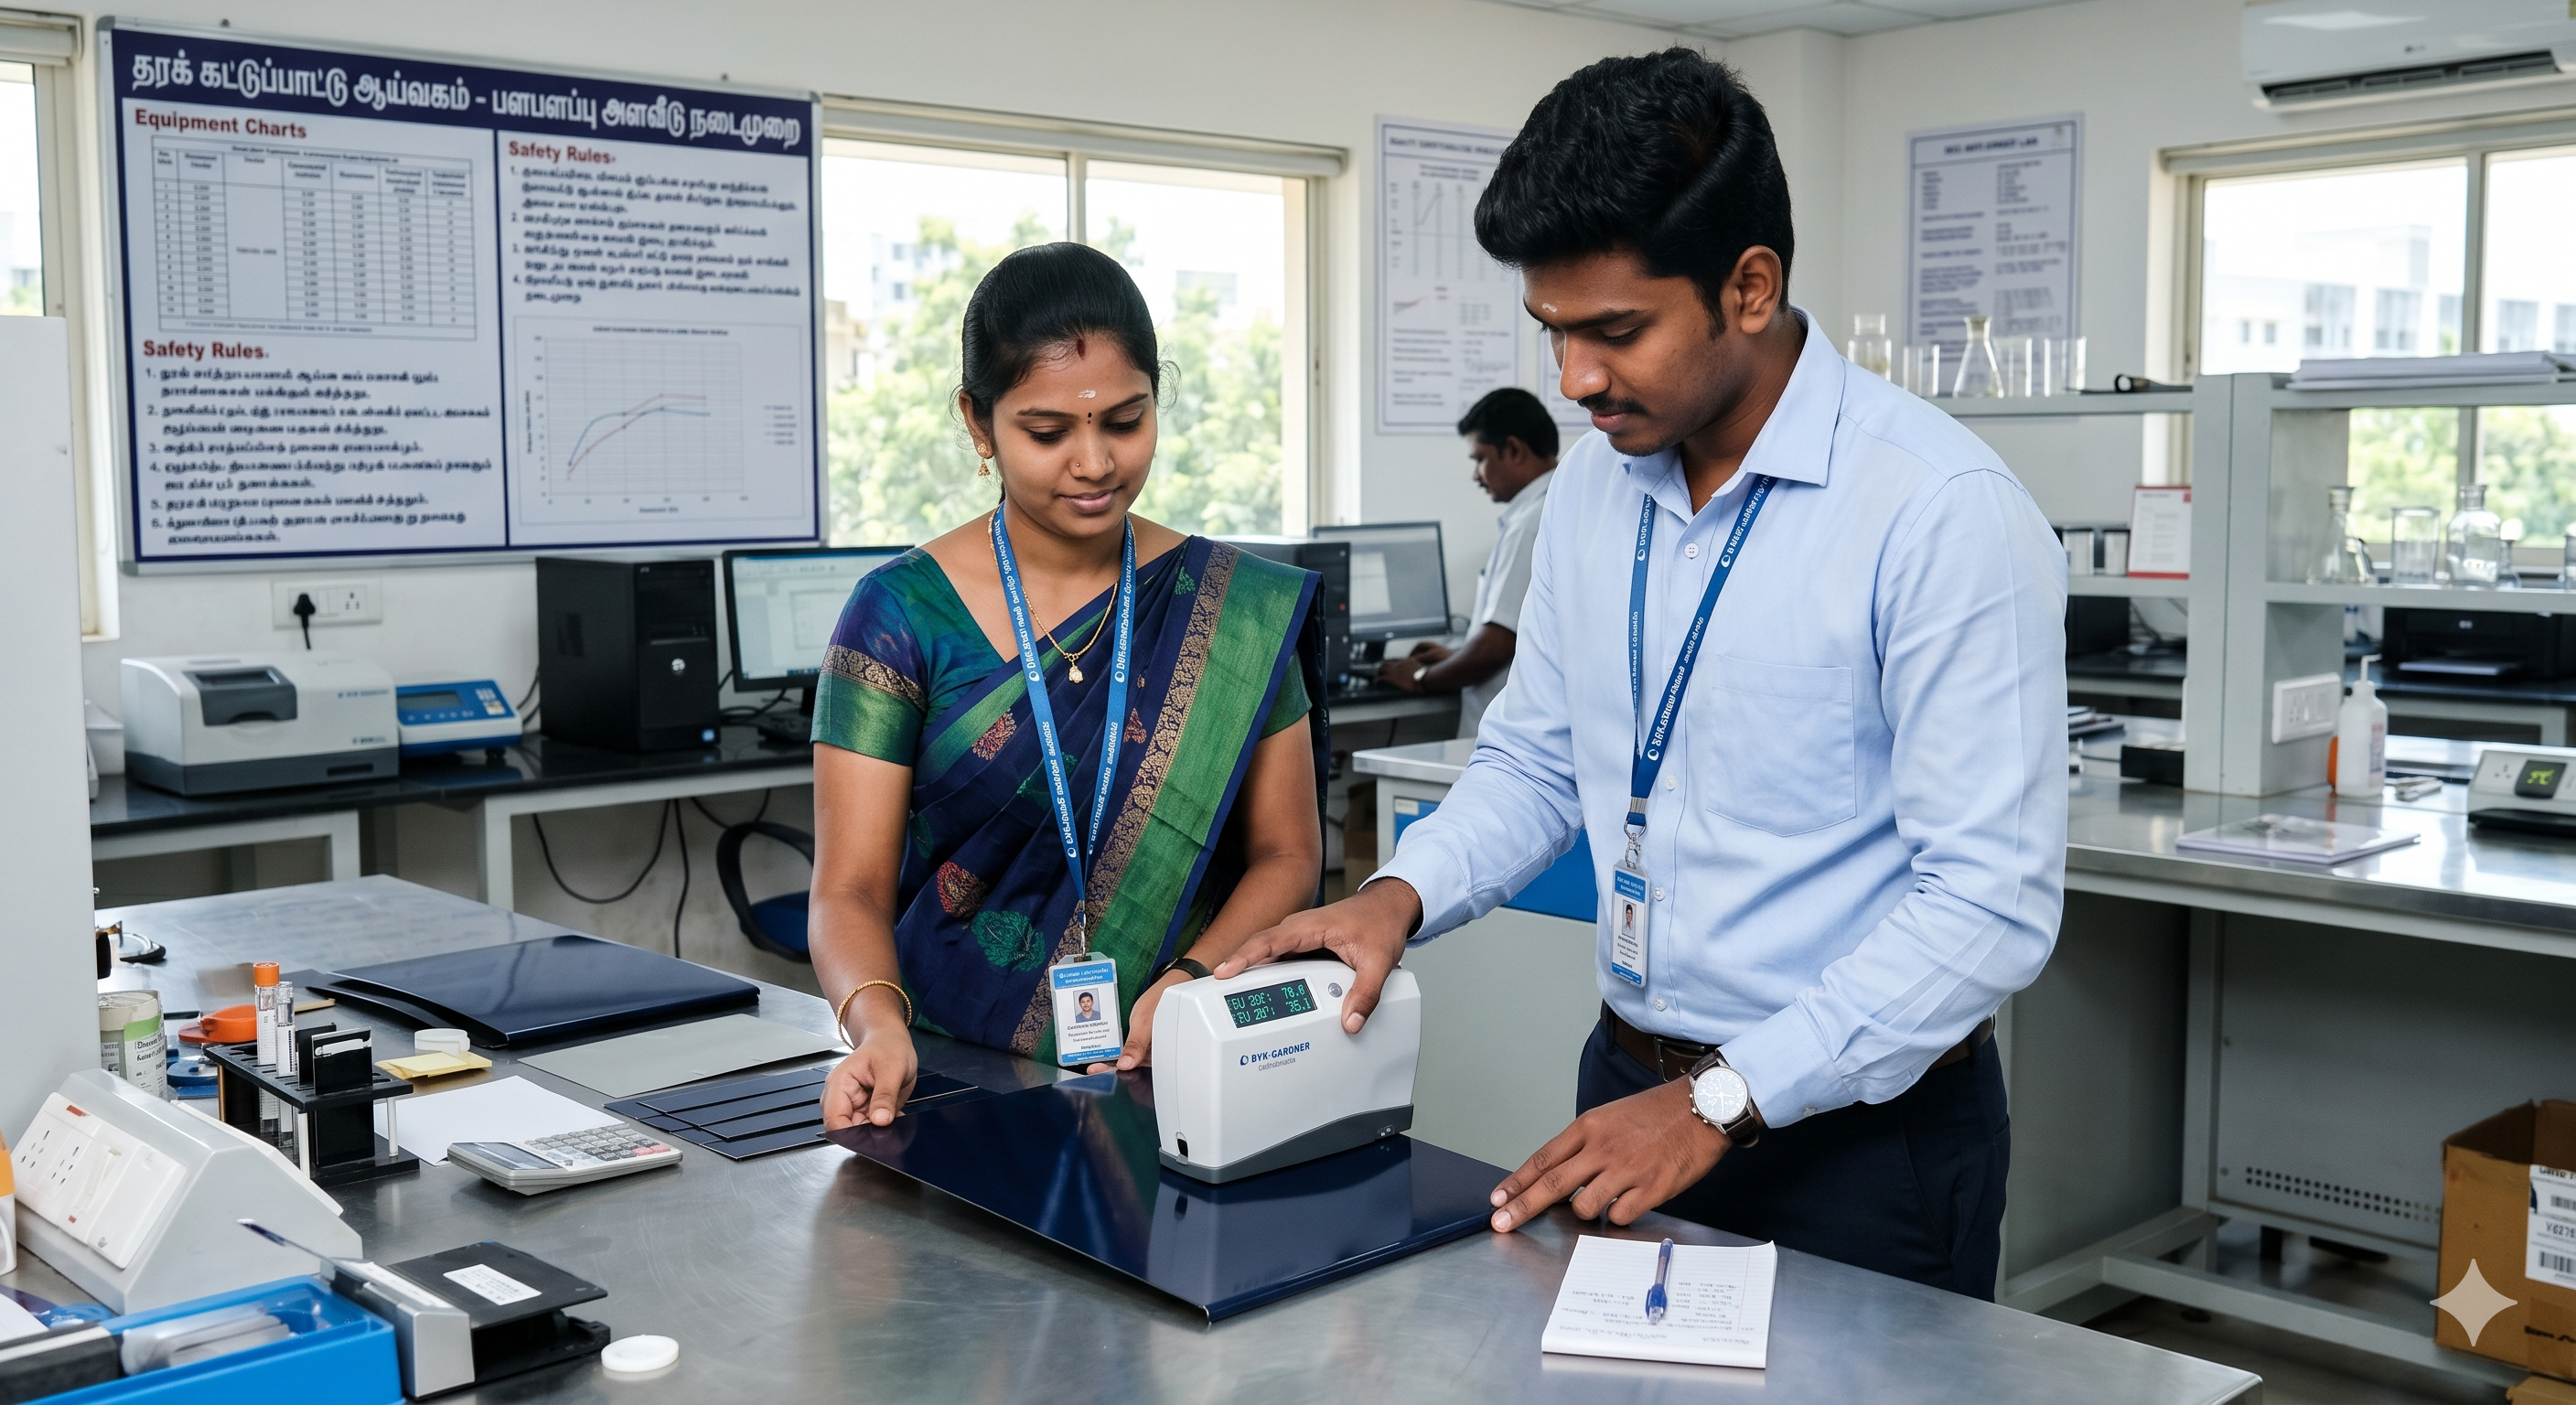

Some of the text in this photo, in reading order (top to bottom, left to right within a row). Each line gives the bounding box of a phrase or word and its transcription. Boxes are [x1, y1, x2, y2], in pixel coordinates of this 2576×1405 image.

[132, 48, 194, 91] தரக்
[199, 57, 349, 108] கட்டுப்பாட்டு
[353, 70, 470, 112] ஆய்வகம்
[492, 87, 597, 131] பளபளப்பு
[601, 94, 686, 138] அளவீடு
[689, 108, 801, 151] நடைமுறை
[134, 108, 307, 140] Equipment Charts
[509, 141, 561, 164] Safety
[143, 339, 205, 362] Safety
[1251, 1042, 1310, 1063] BYK-GARDNER
